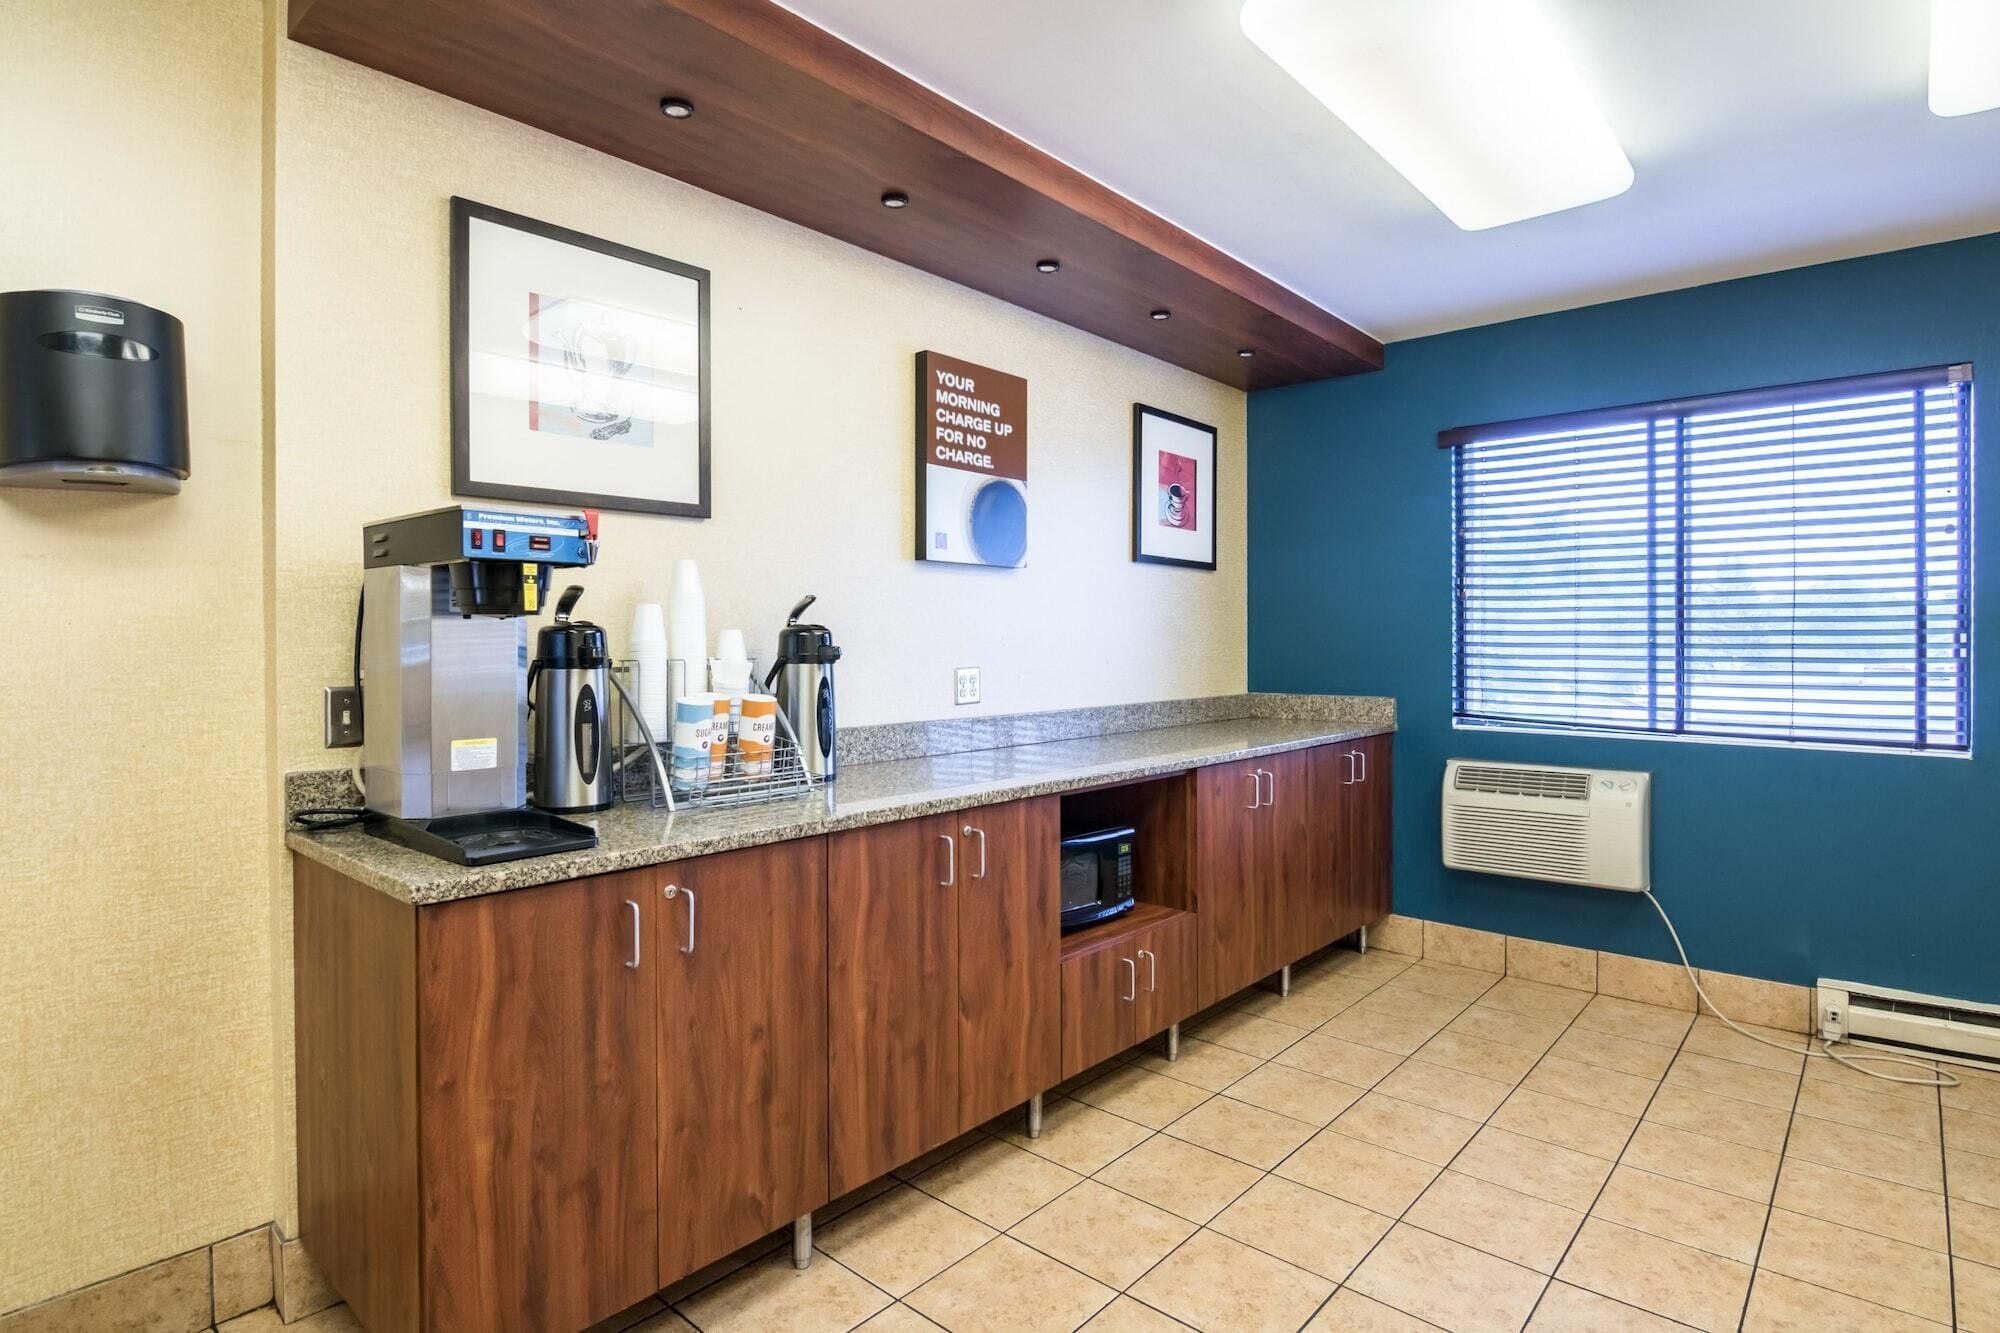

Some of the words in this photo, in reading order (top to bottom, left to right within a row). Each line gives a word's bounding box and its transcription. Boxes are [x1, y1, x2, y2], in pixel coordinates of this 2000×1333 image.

[936, 369, 975, 393] YOUR
[936, 389, 1000, 418] MORNING
[936, 408, 992, 433] CHARGE
[994, 421, 1013, 437] UP
[936, 426, 964, 445] FOR
[966, 433, 987, 450] NO
[936, 445, 994, 469] CHARGE.
